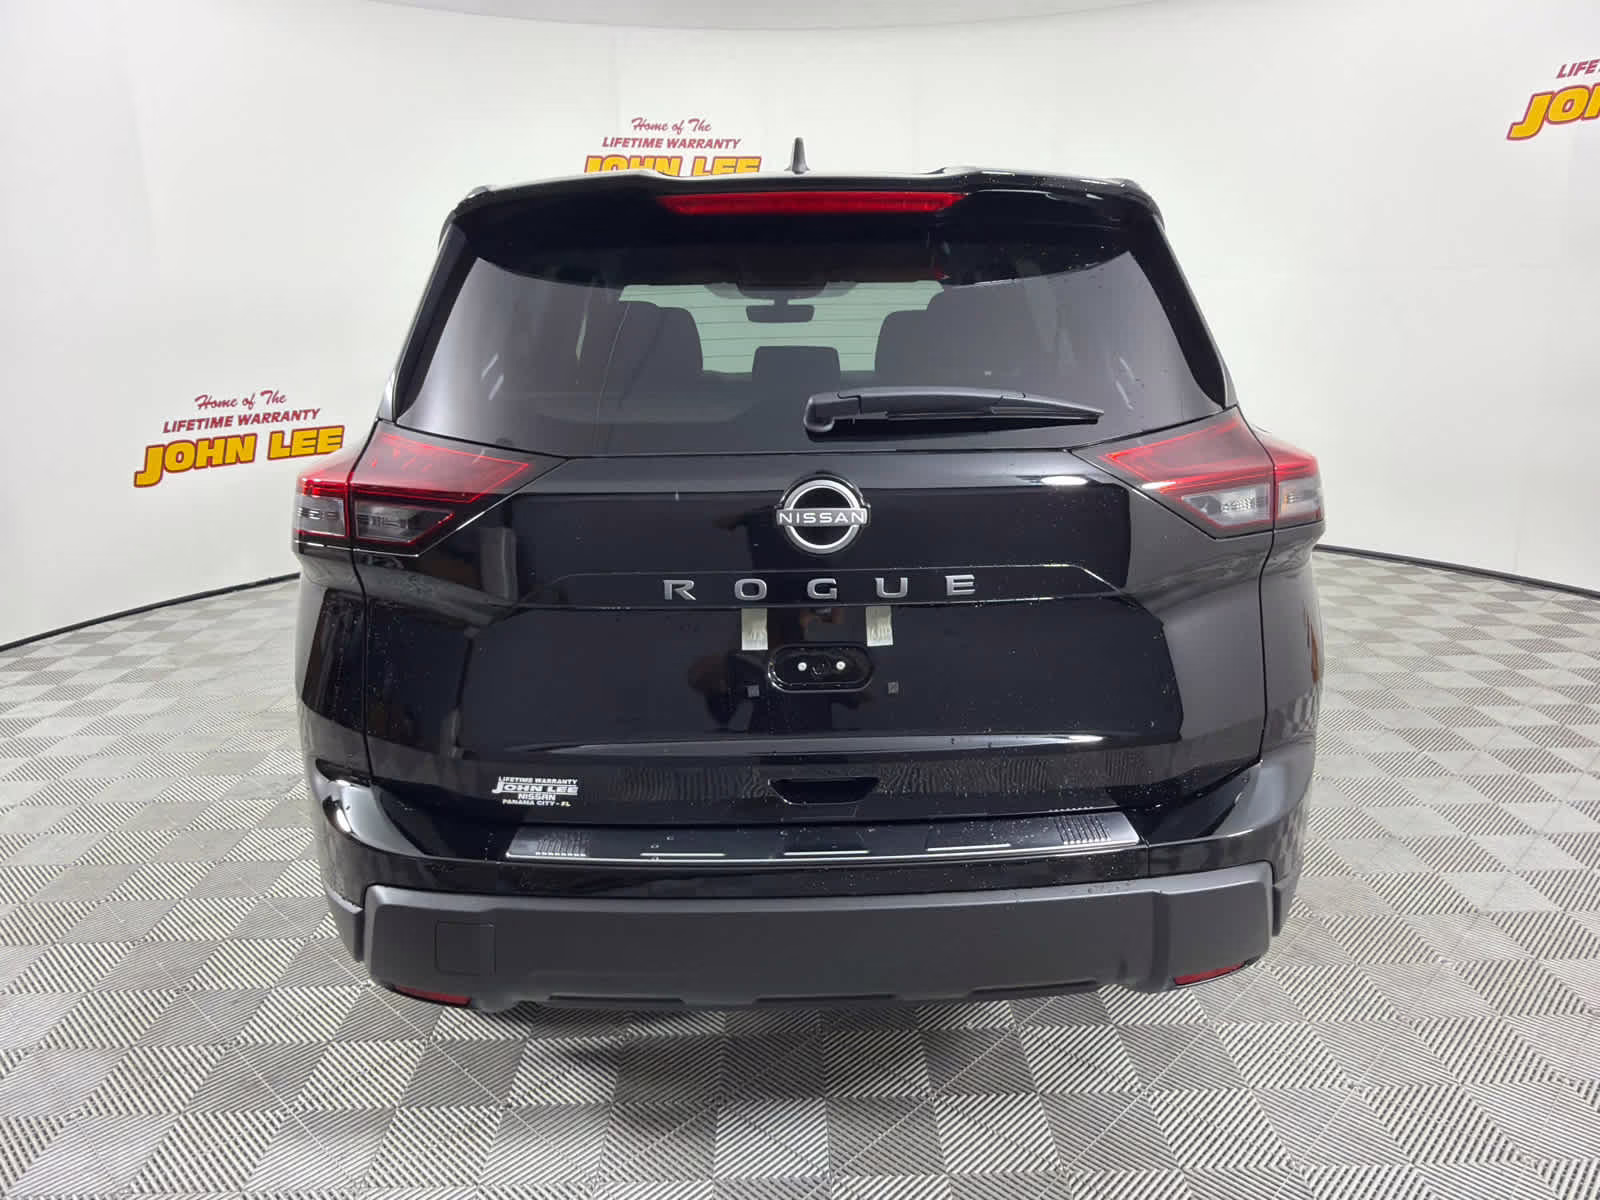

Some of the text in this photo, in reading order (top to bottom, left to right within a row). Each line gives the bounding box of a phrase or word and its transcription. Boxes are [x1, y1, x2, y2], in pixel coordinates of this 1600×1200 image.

[1556, 58, 1600, 79] LIFE
[631, 117, 712, 135] Home of The
[602, 137, 742, 150] LIFETIME WARRANTY
[691, 156, 762, 177] LEE
[194, 390, 287, 411] Home of The
[162, 408, 321, 434] LIFETIME WARRANTY
[133, 425, 345, 488] JOHN LEE
[778, 511, 866, 525] NISSAN
[662, 574, 976, 602] ROGUE
[491, 781, 579, 794] JOHN LEE
[535, 777, 578, 785] WARRANTY
[502, 798, 535, 806] PANAMA
[518, 793, 556, 801] NISSAN
